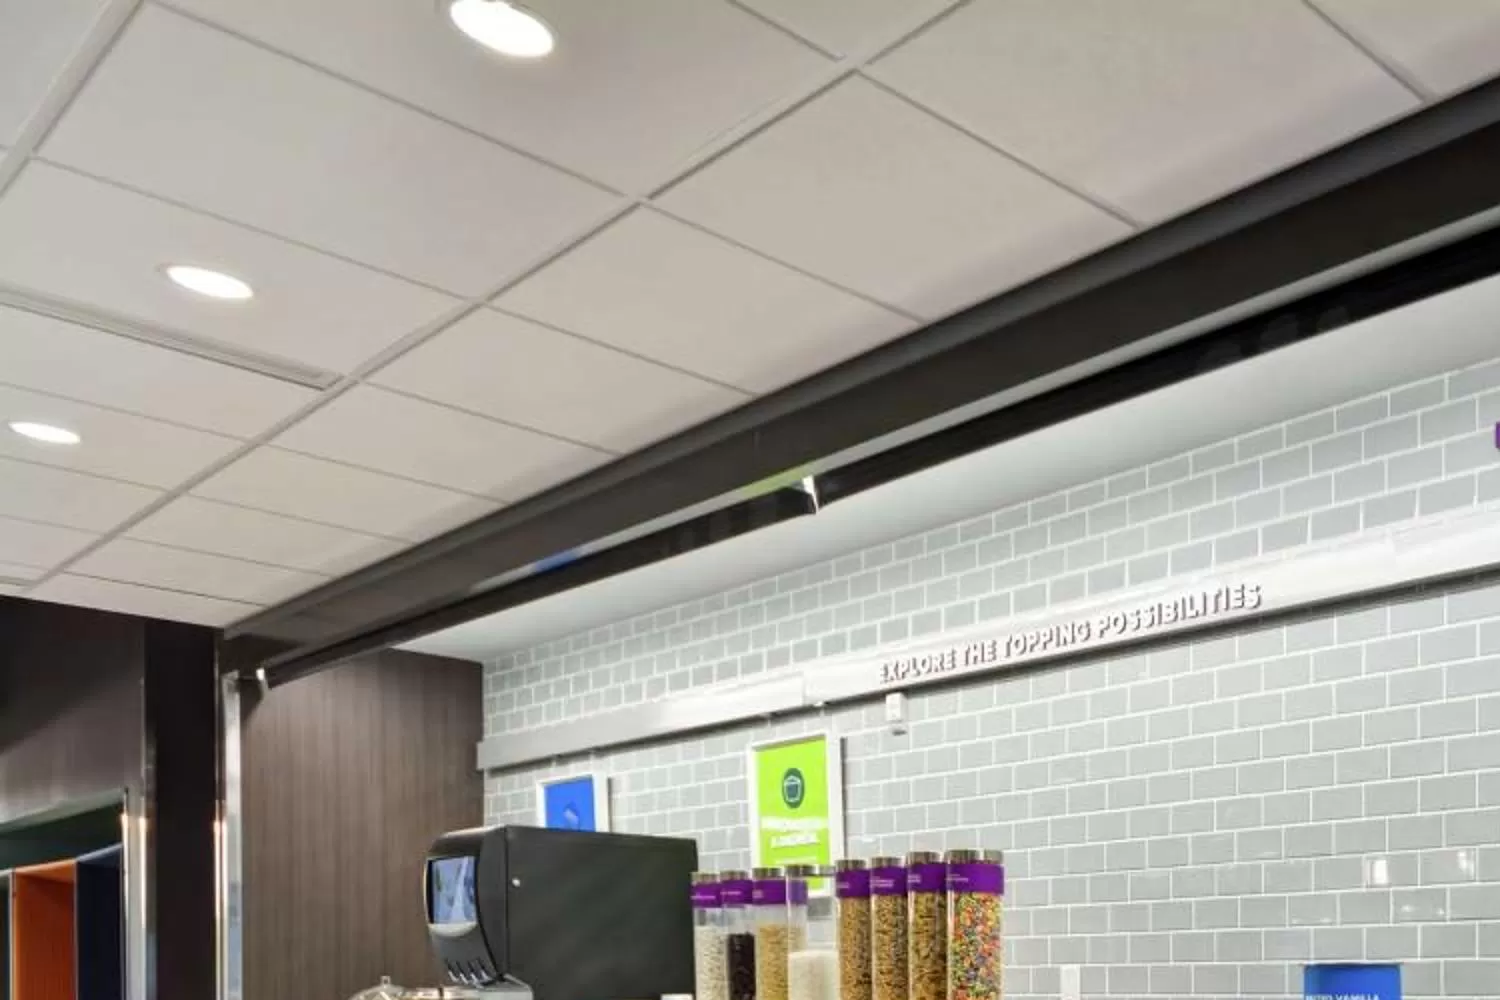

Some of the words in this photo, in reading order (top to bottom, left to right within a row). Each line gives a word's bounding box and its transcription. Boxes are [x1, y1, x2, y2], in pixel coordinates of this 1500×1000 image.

[878, 647, 957, 684] EXPLORE
[963, 638, 998, 668] THE
[1003, 620, 1092, 659] TOPPING
[1098, 583, 1263, 639] POSSIBILITIES
